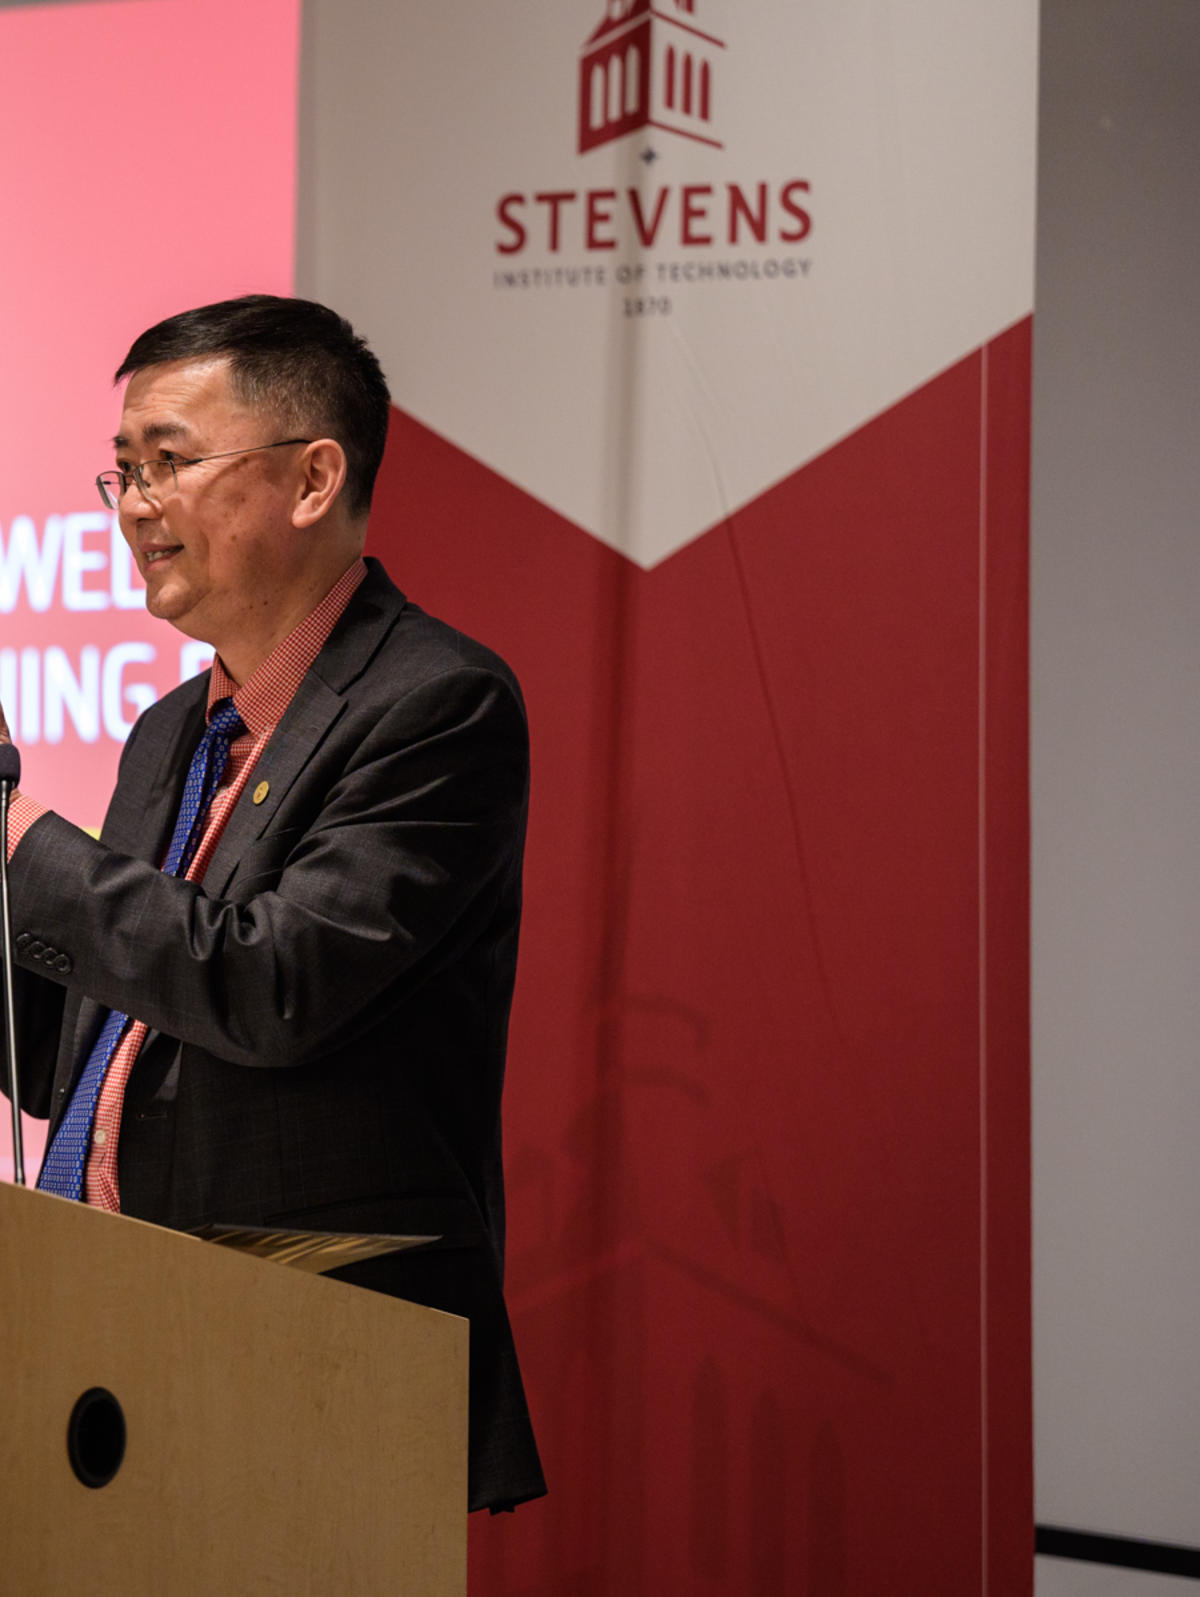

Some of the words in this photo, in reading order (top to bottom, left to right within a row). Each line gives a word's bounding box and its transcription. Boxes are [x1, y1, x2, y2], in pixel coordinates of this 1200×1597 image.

[496, 180, 813, 254] STEVENS
[493, 267, 606, 289] INSTITUTE
[615, 264, 645, 285] OF
[656, 257, 812, 283] TECHNOLOGY
